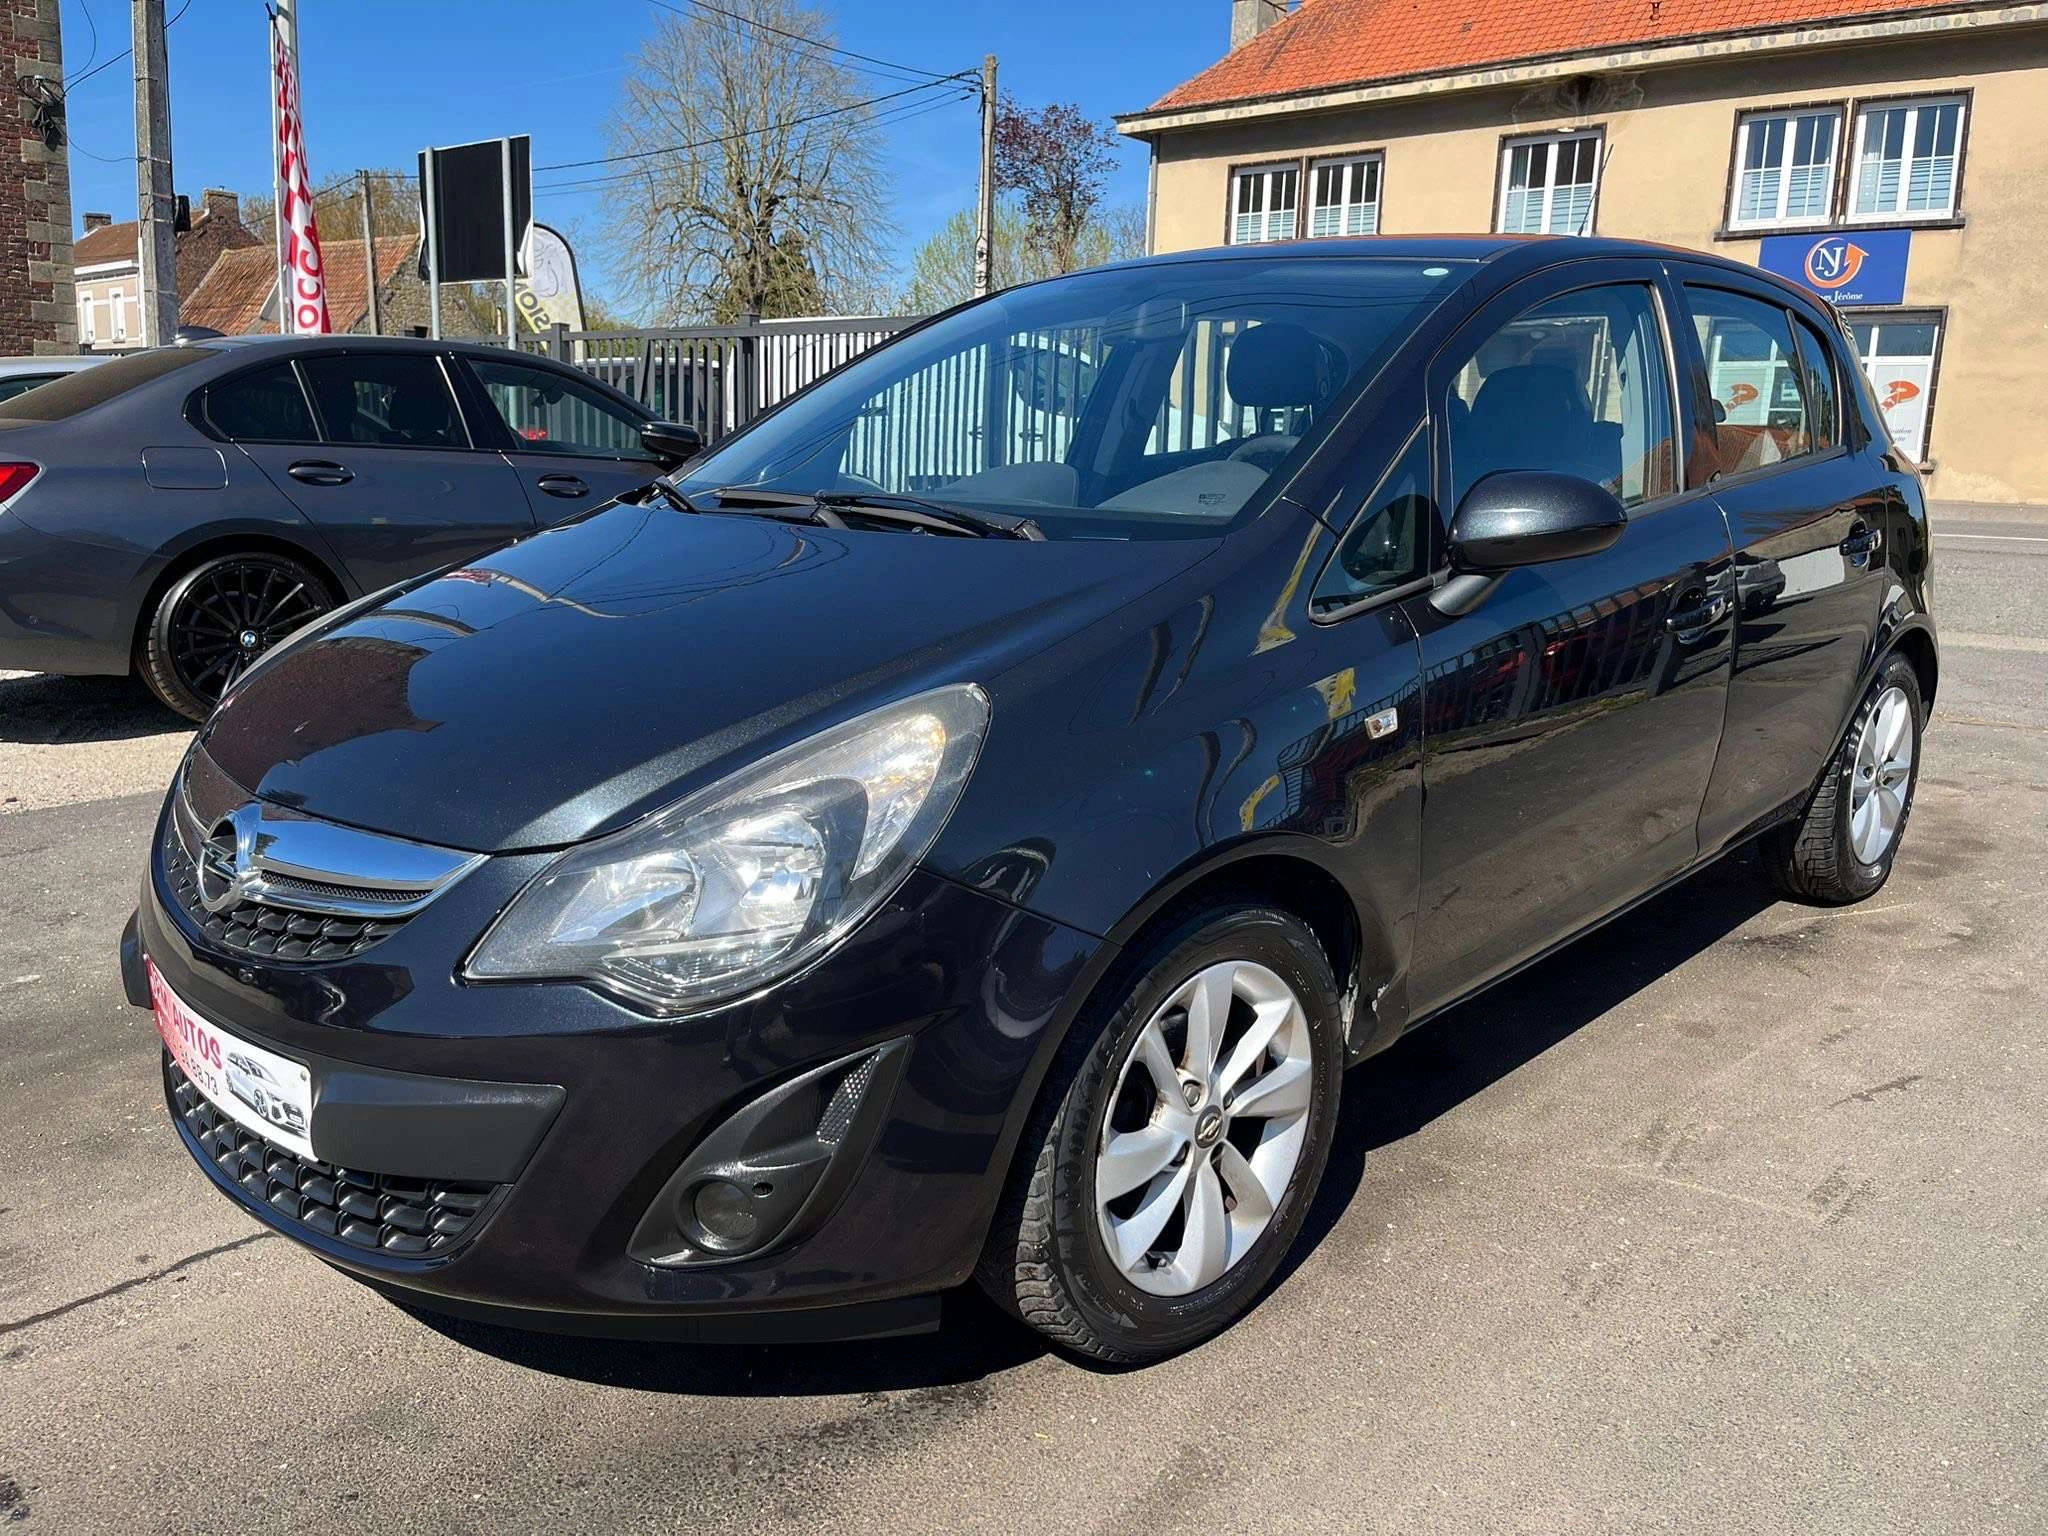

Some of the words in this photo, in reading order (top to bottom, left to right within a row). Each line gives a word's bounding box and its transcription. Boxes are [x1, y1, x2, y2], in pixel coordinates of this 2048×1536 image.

[1815, 246, 1845, 277] NJ
[1830, 290, 1864, 304] Jérôme
[172, 1002, 223, 1070] AUTOS
